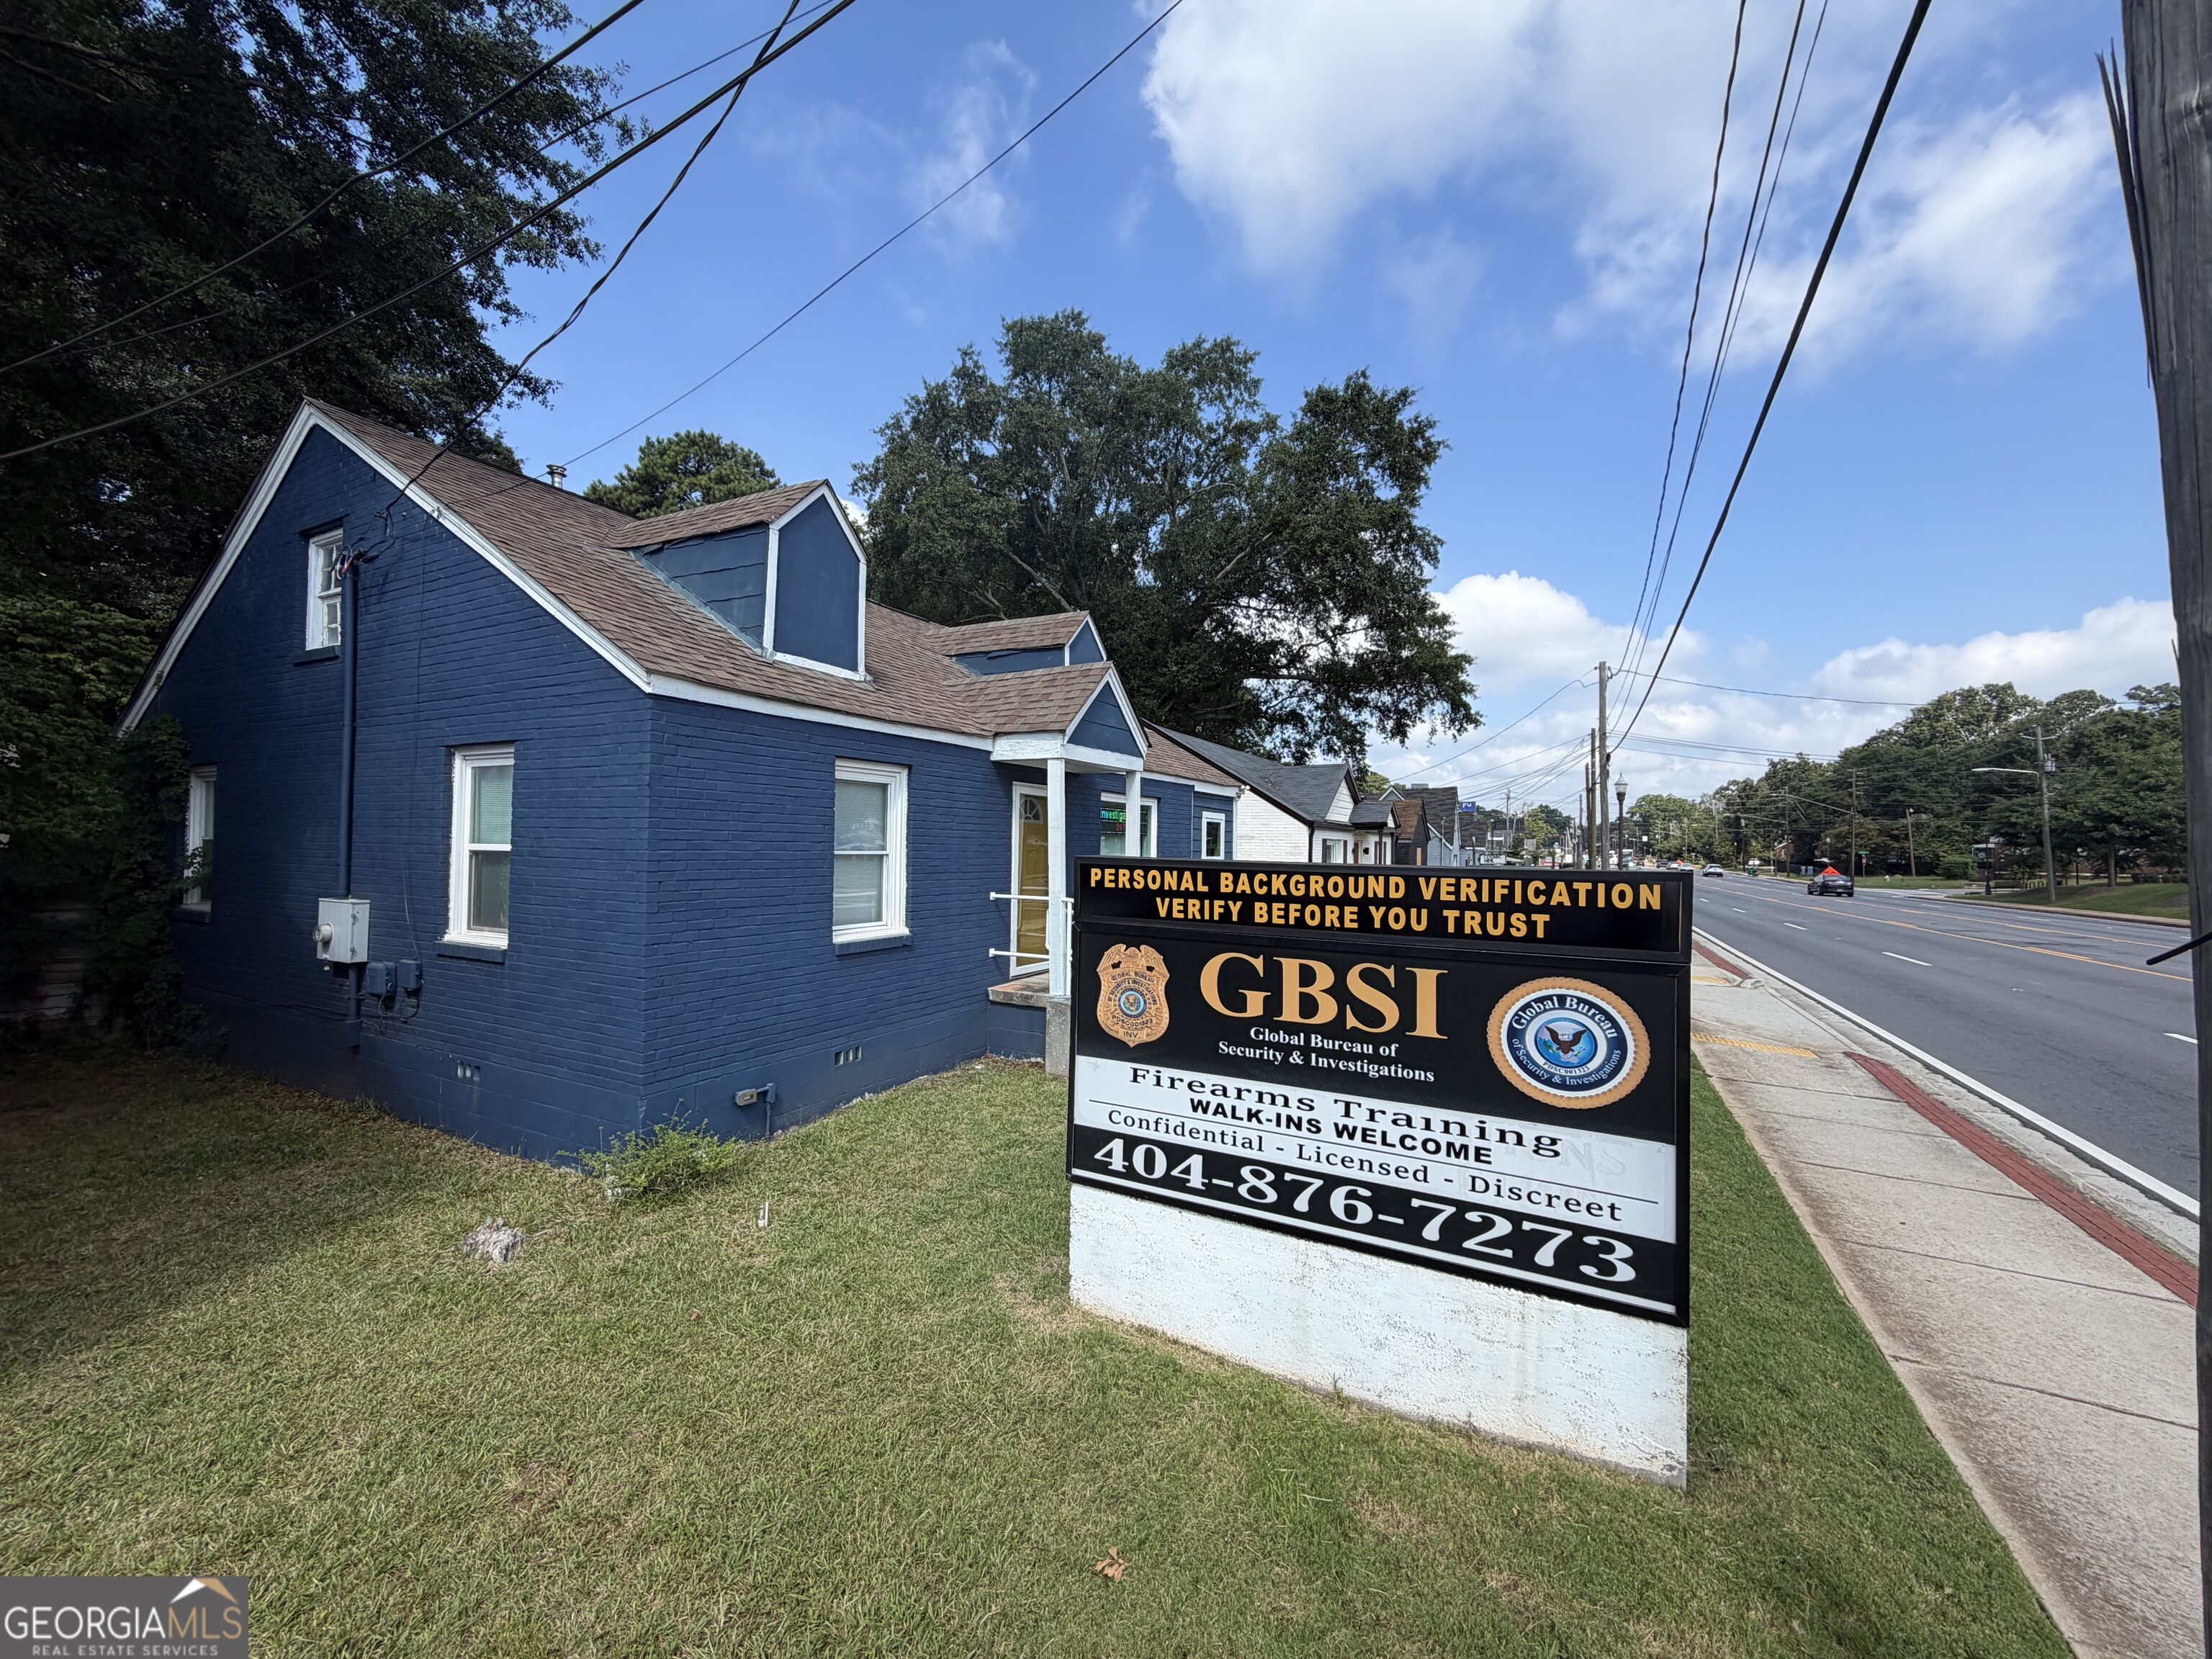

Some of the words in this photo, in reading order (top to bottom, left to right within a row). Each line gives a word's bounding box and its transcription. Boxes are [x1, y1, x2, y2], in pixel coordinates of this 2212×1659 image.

[1090, 868, 1209, 892] PERSONAL
[1220, 872, 1406, 899] BACKGROUND
[1418, 876, 1661, 910] VERIFICATION
[1156, 897, 1243, 922] VERIFY
[1254, 902, 1359, 929] BEFORE
[1368, 906, 1429, 932] YOU
[1442, 909, 1550, 939] TRUST
[1110, 979, 1127, 995] SECURITY
[1131, 979, 1158, 1006] INVESTIGATIONS
[1111, 971, 1130, 981] GLOBAL
[1134, 971, 1155, 983] BUREAU
[1200, 952, 1448, 1039] GBSI
[1112, 1014, 1153, 1028] PDSC001323
[1123, 1030, 1141, 1039] INV.
[1512, 996, 1559, 1030] Global
[1565, 997, 1619, 1038] Bureau
[1250, 1027, 1305, 1046] Global
[1310, 1034, 1374, 1054] Bureau
[1379, 1044, 1399, 1057] of
[1512, 1038, 1521, 1048] of
[1218, 1040, 1285, 1065] Security
[1289, 1051, 1305, 1065] &
[1310, 1053, 1435, 1082] Investigations
[1516, 1047, 1550, 1080] Security
[1542, 1061, 1591, 1074] PDSC001323
[1565, 1049, 1621, 1085] Investigations
[1552, 1075, 1563, 1084] &
[1129, 1066, 1316, 1112] Firearms
[1334, 1099, 1563, 1158] Training
[1190, 1097, 1323, 1135] WALK-INS
[1334, 1122, 1493, 1165] WELCOME
[1108, 1110, 1264, 1152] Confidential
[1296, 1143, 1430, 1184] Licensed
[1469, 1174, 1622, 1222] Discreet
[1094, 1138, 1637, 1282] 404-876-7273
